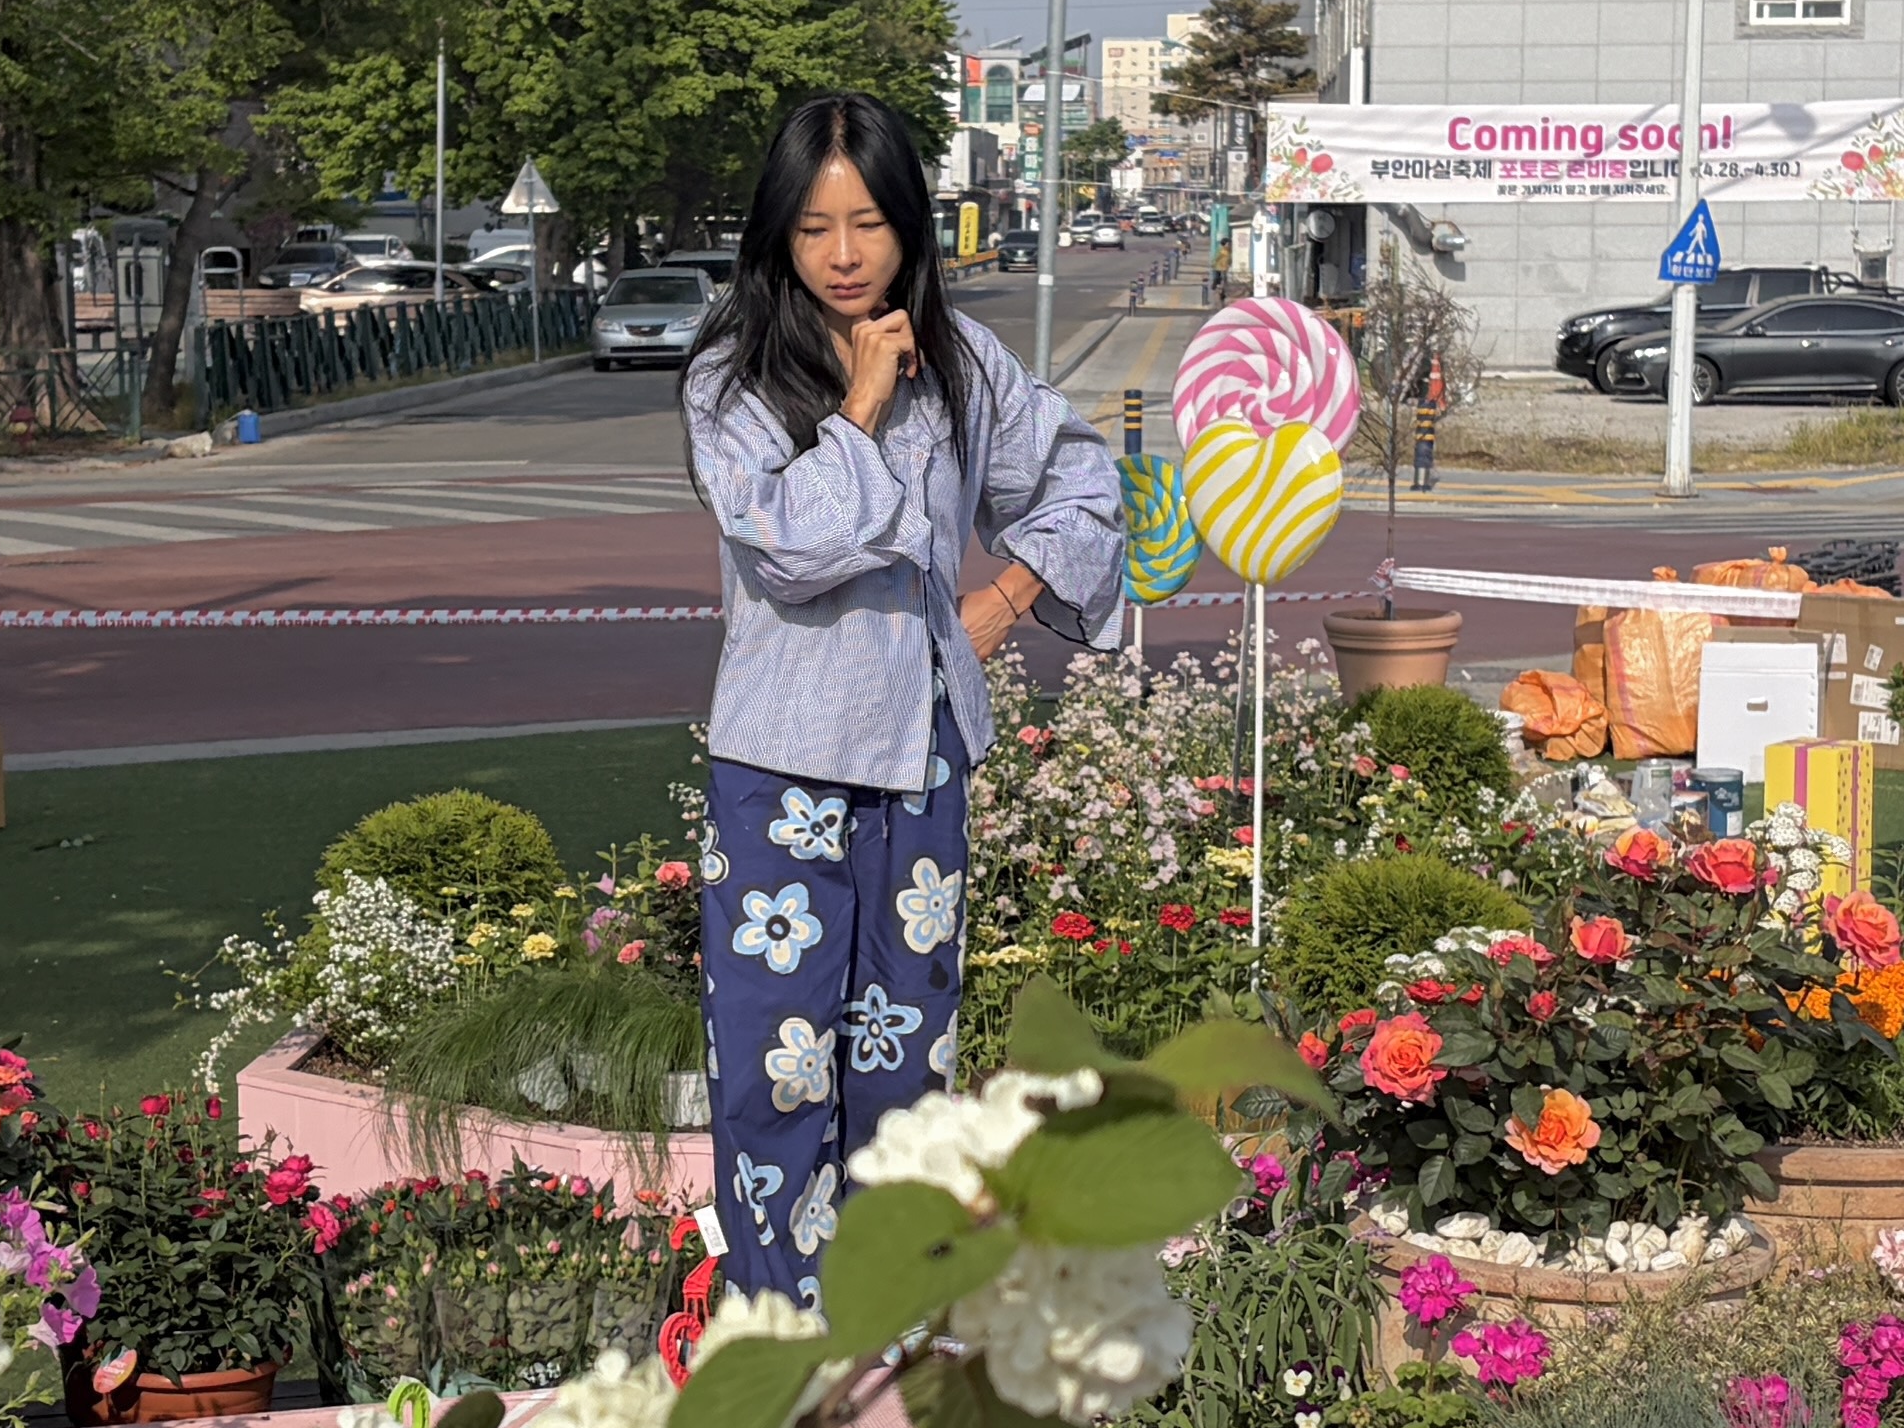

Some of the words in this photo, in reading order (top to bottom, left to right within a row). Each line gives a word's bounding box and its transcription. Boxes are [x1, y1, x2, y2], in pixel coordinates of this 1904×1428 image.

[1448, 116, 1603, 157] Coming
[1618, 115, 1733, 151] soon!
[1370, 159, 1492, 180] 부안마실축제
[1498, 160, 1563, 178] 포토존
